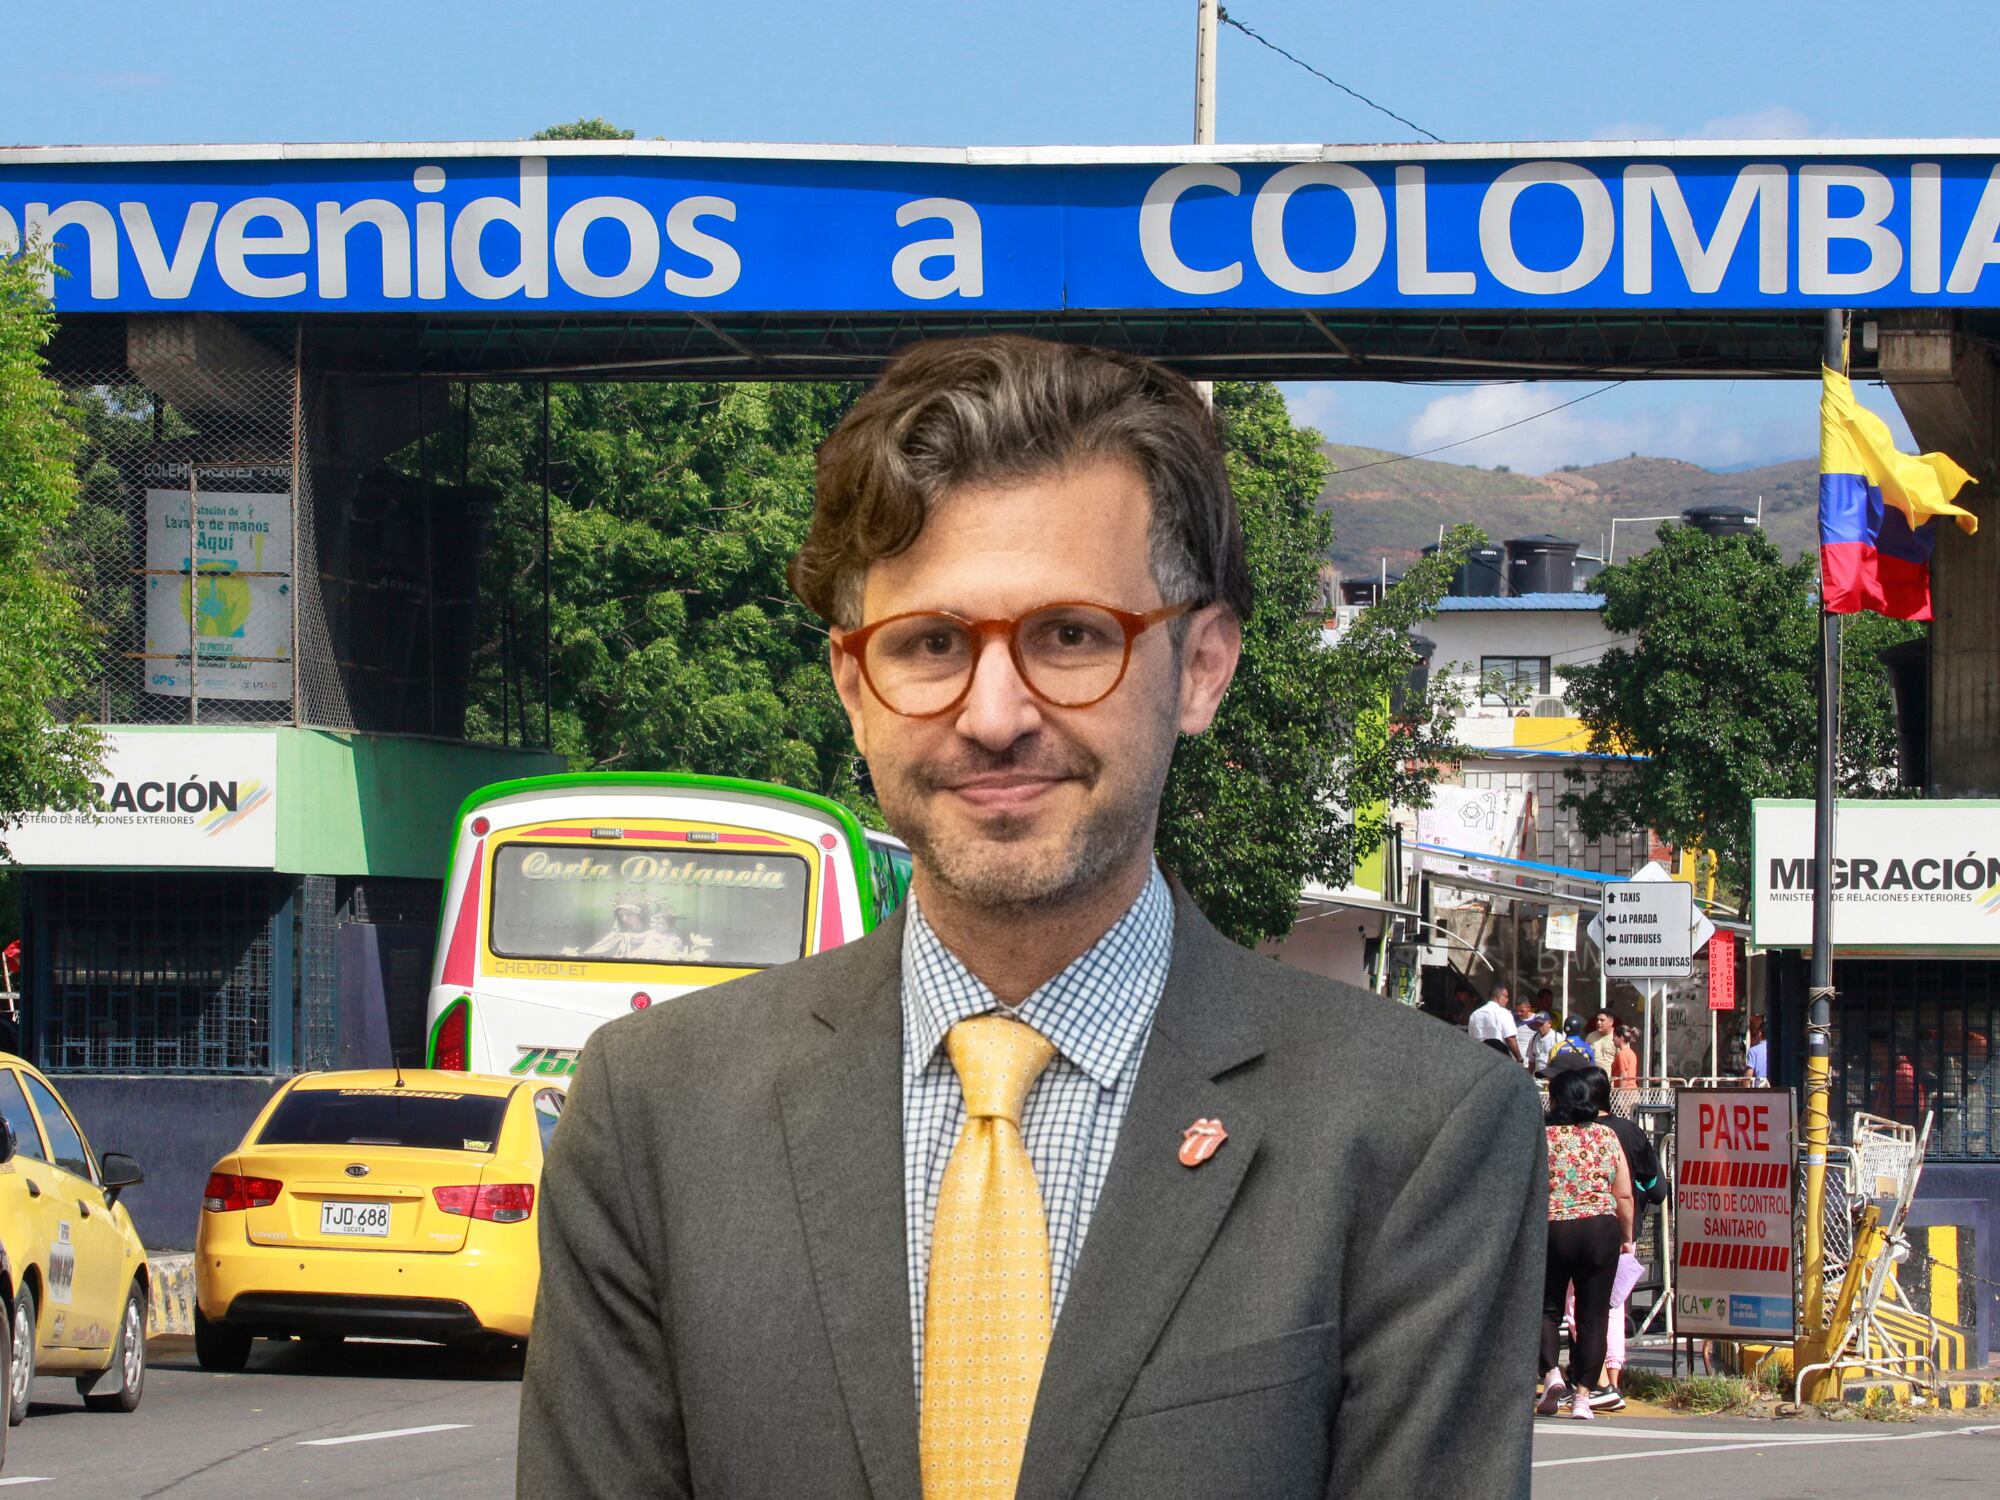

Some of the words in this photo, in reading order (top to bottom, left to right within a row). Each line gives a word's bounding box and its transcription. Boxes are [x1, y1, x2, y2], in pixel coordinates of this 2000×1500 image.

[0, 156, 742, 299] nvenidos
[891, 197, 983, 300] a
[197, 505, 226, 516] stación
[165, 514, 205, 530] Lavao
[50, 774, 238, 813] RACIÓN
[137, 815, 195, 825] EXTERIORES
[521, 851, 613, 882] Corta
[620, 855, 786, 890] Distancia
[1619, 892, 1641, 903] TAXIS
[1770, 893, 1815, 902] MINISTE
[1847, 893, 1909, 902] RELACIONES
[1912, 893, 1972, 902] EXTERIORES
[1618, 914, 1628, 924] LA
[1629, 914, 1658, 925] PARADA
[1618, 934, 1662, 944] AUTOBUSES
[1618, 956, 1648, 967] CAMBIO
[1649, 956, 1658, 967] DE
[1660, 956, 1690, 967] DIVISAS
[510, 1045, 583, 1077] 75
[1699, 1103, 1770, 1151] PARE
[1679, 1191, 1720, 1212] PUESTO
[1723, 1193, 1738, 1212] DE
[1740, 1194, 1790, 1215] CONTROL
[1704, 1217, 1766, 1239] SANITARIO
[1678, 1294, 1699, 1314] ICA
